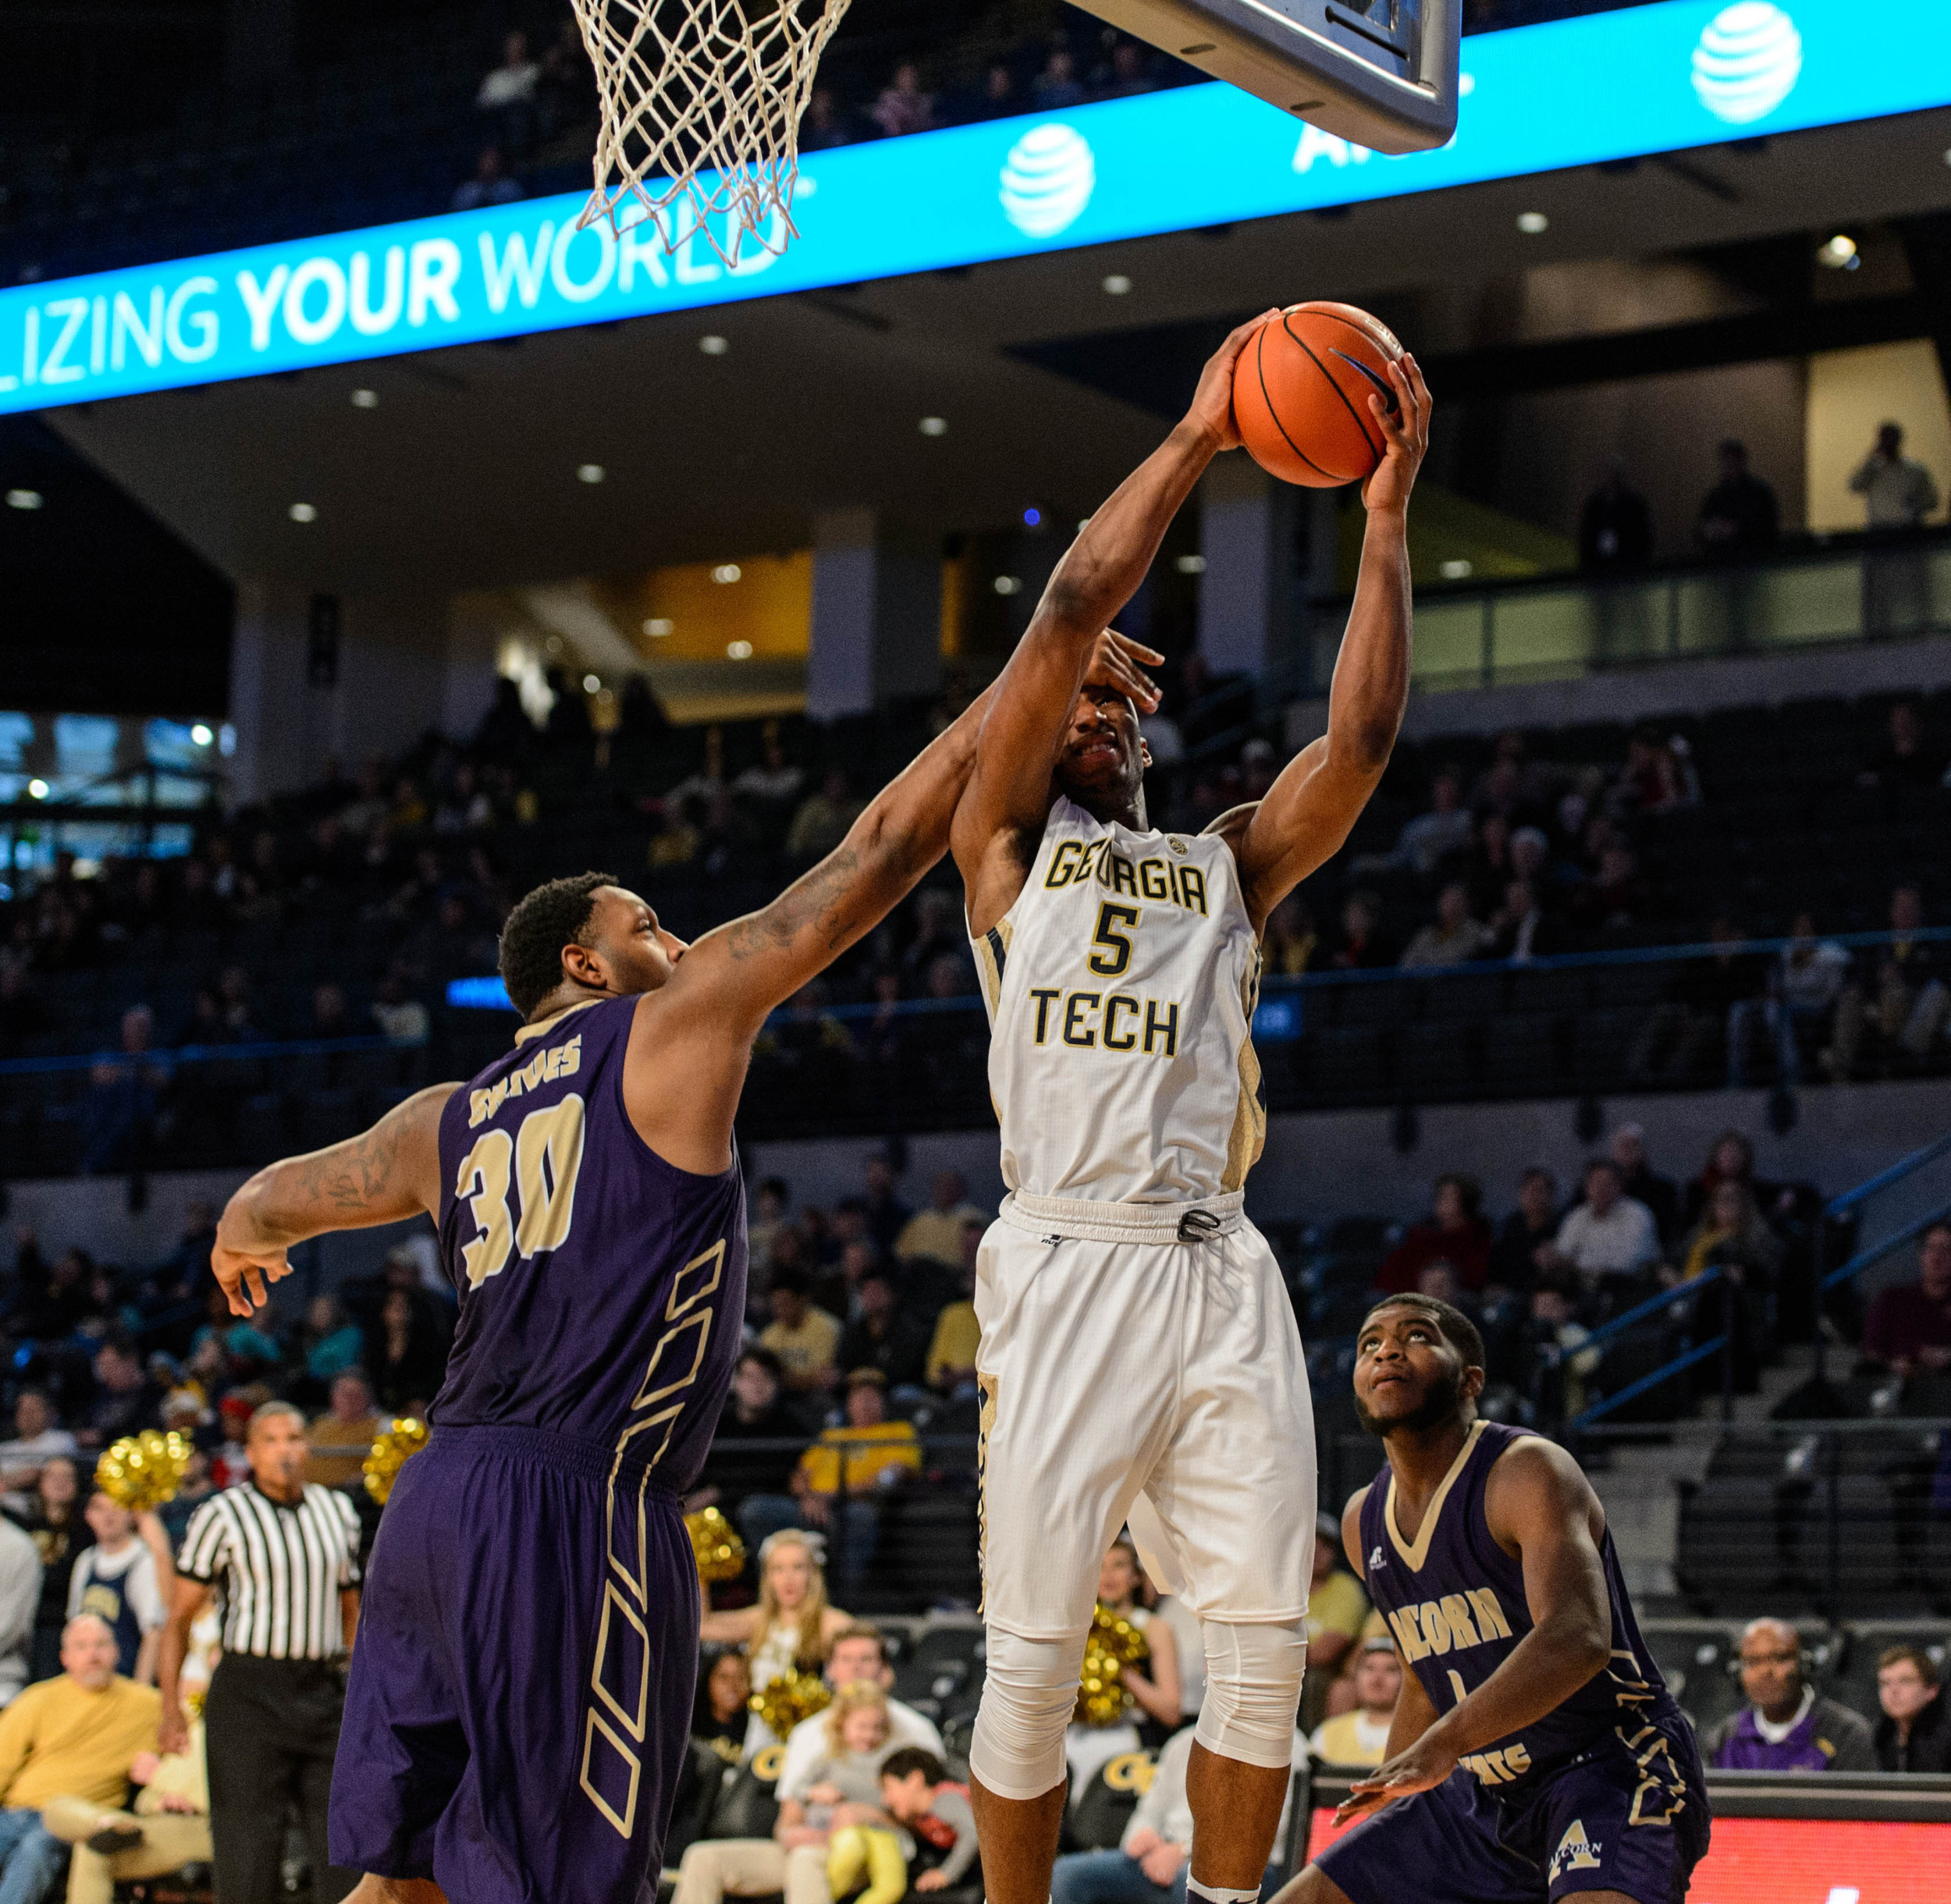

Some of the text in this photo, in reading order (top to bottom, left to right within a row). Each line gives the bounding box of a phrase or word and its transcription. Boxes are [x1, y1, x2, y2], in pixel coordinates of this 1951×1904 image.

[236, 238, 461, 353] YOUR
[478, 183, 790, 314] WORLD
[1044, 837, 1209, 910] GEORGIA
[1087, 900, 1141, 978] 5
[1029, 988, 1180, 1058] TECH
[455, 1092, 585, 1292] 30
